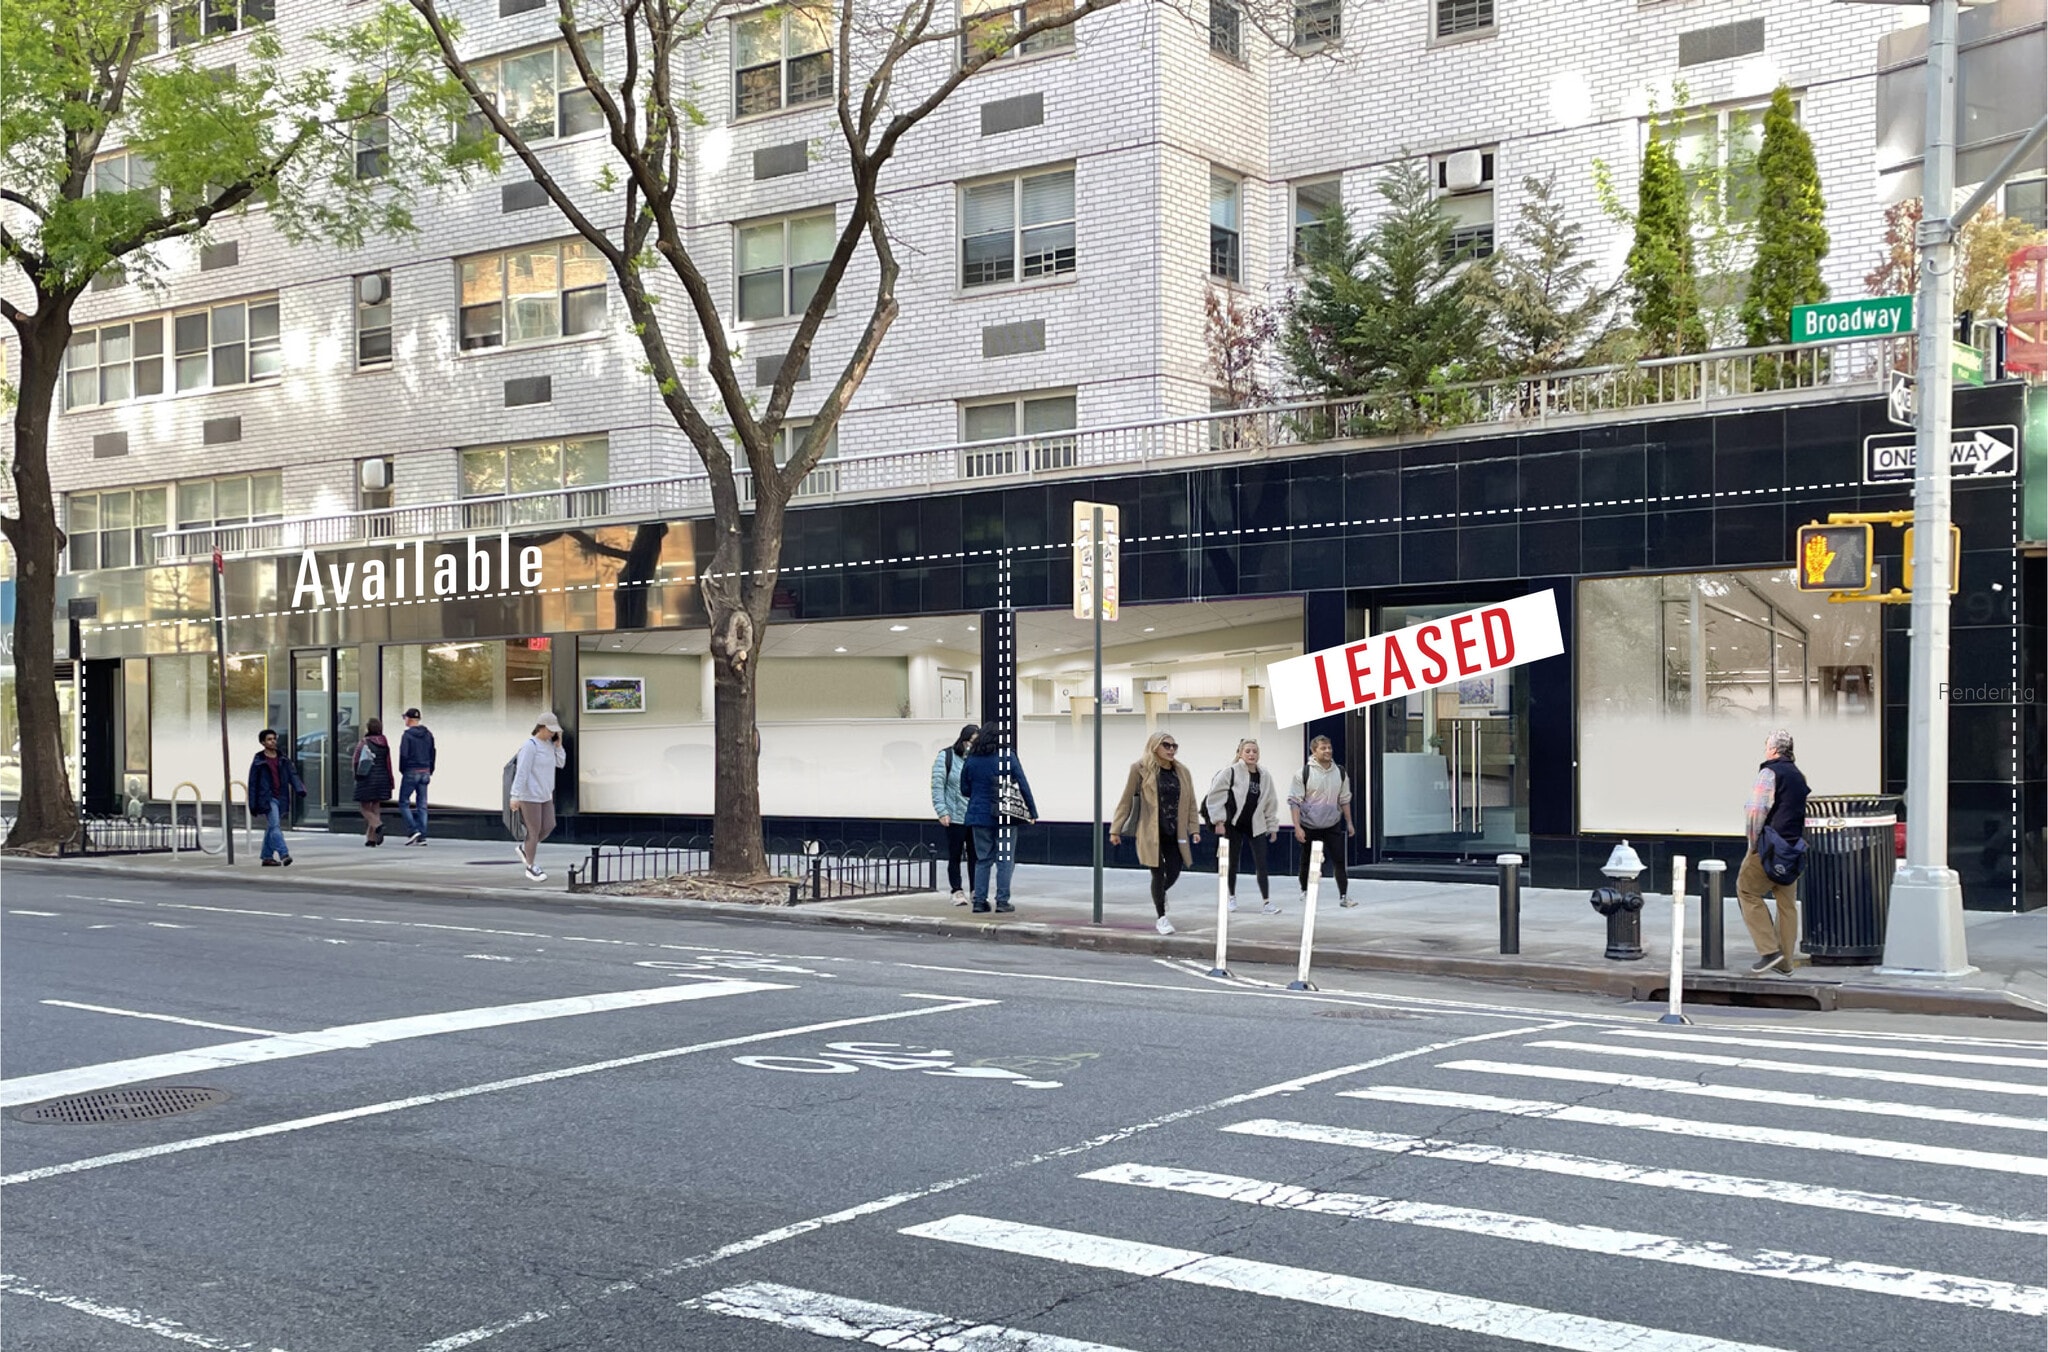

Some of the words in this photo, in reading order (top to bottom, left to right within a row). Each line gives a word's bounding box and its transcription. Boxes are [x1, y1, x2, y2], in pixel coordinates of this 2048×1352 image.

[1806, 307, 1902, 335] Broadway
[1880, 448, 1916, 467] ONE
[1950, 442, 1995, 463] WAY
